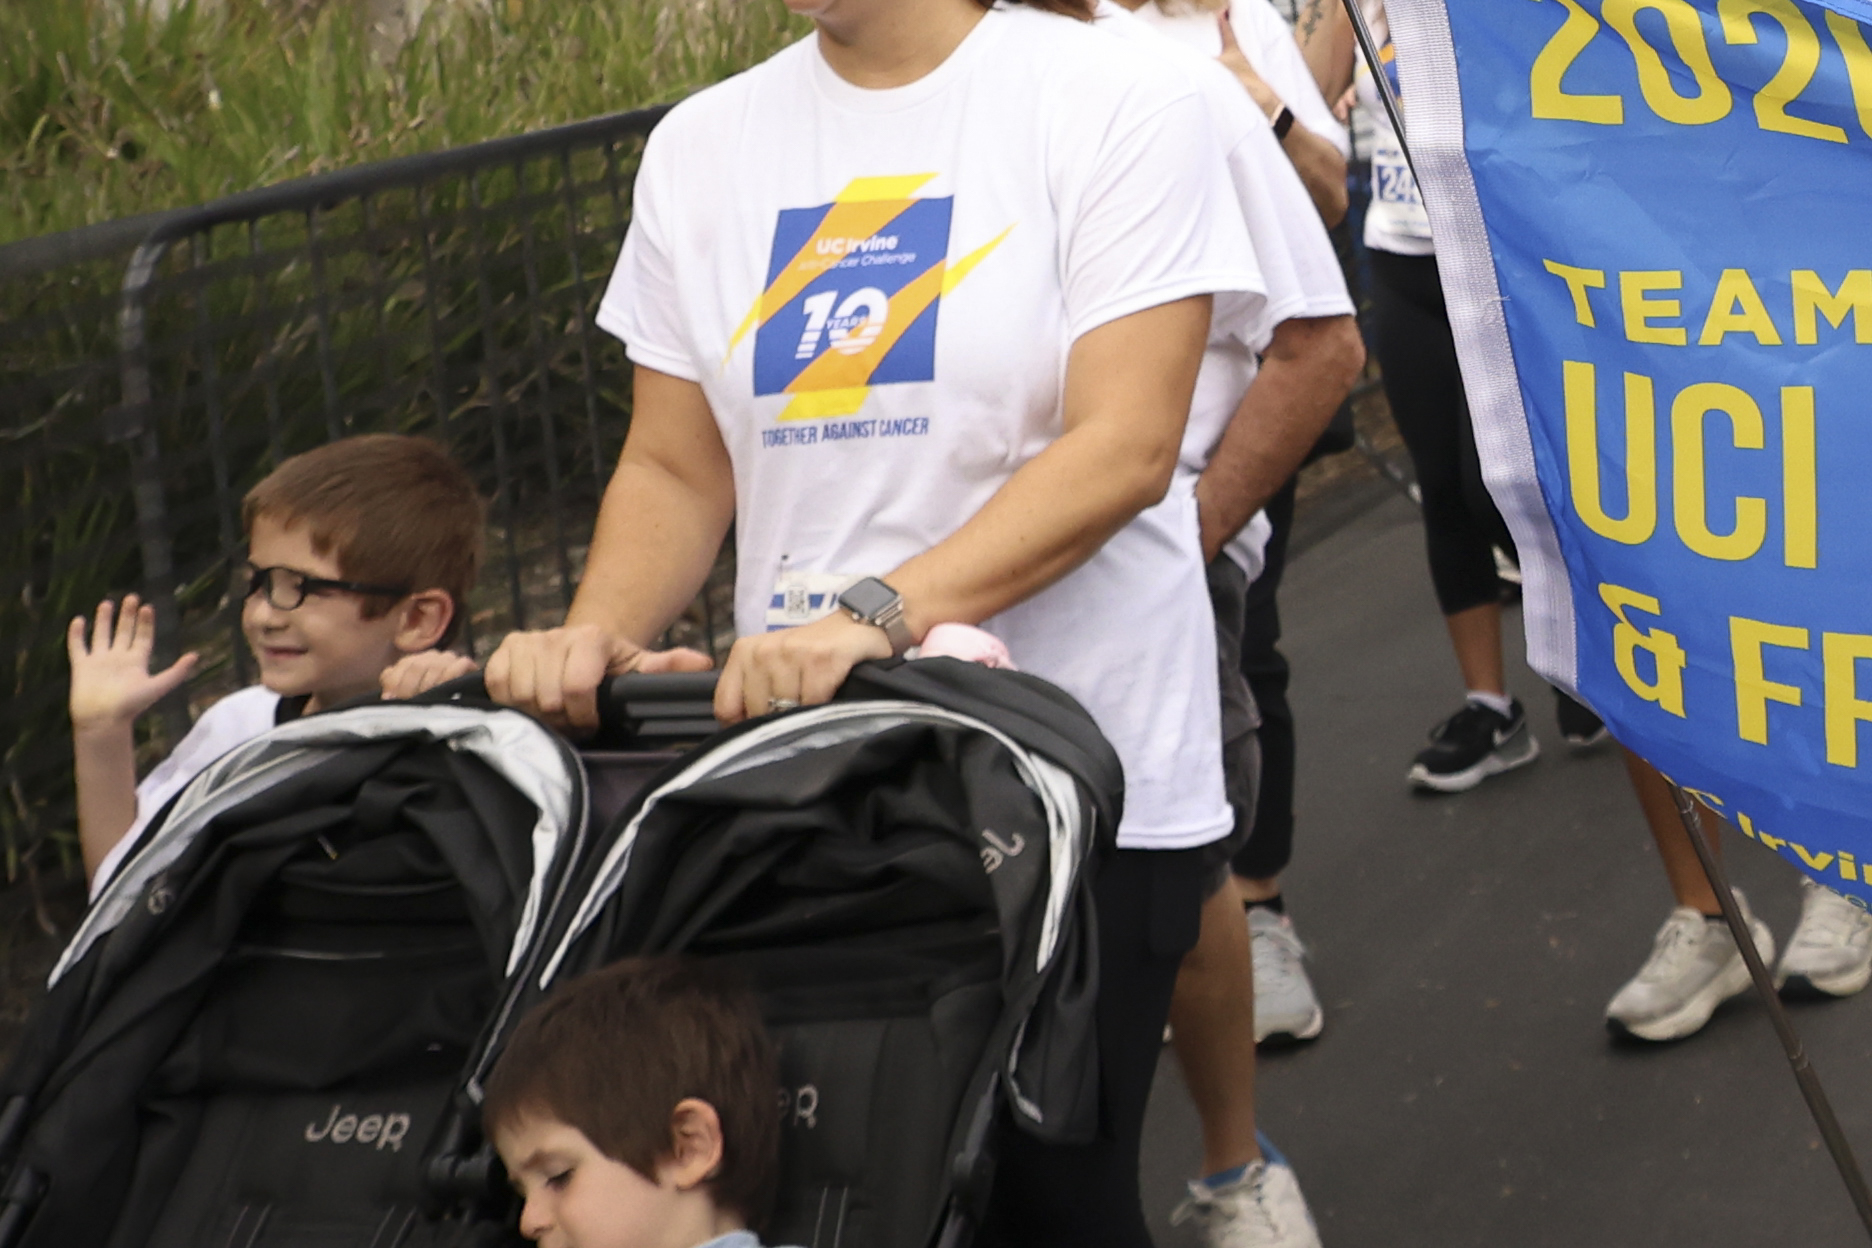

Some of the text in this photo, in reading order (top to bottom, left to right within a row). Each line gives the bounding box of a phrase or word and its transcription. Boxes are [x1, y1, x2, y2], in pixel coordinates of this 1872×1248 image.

[1382, 166, 1416, 203] 24
[816, 234, 899, 255] UC Irvine
[795, 286, 889, 360] 10
[761, 416, 930, 449] TOGETHER AGAINST CANCER
[1562, 359, 1818, 569] UCI
[1597, 582, 1687, 719] &
[304, 1103, 411, 1153] Jeep
